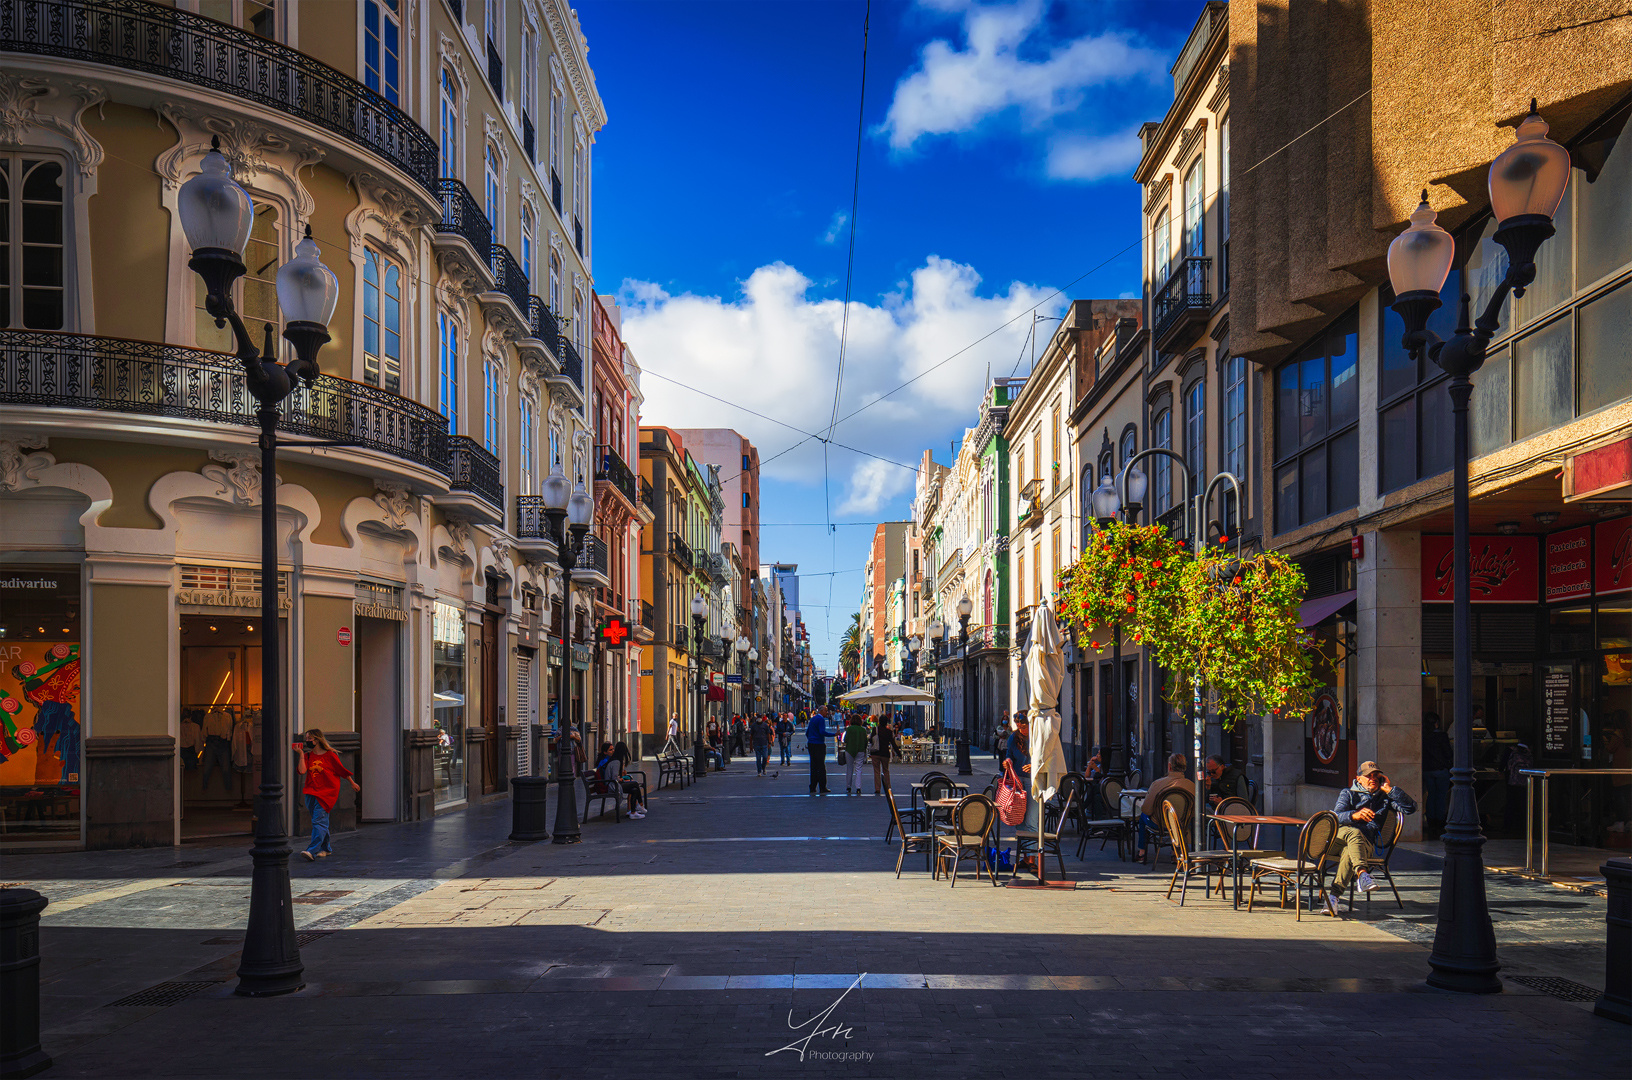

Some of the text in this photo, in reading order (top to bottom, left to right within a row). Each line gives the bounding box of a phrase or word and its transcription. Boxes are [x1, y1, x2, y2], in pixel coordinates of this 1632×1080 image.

[1550, 537, 1587, 554] Pastelería
[1550, 559, 1587, 574] Heladería
[0, 577, 57, 589] adivarius
[1546, 580, 1591, 596] Bombonería
[355, 602, 409, 622] stradivarius
